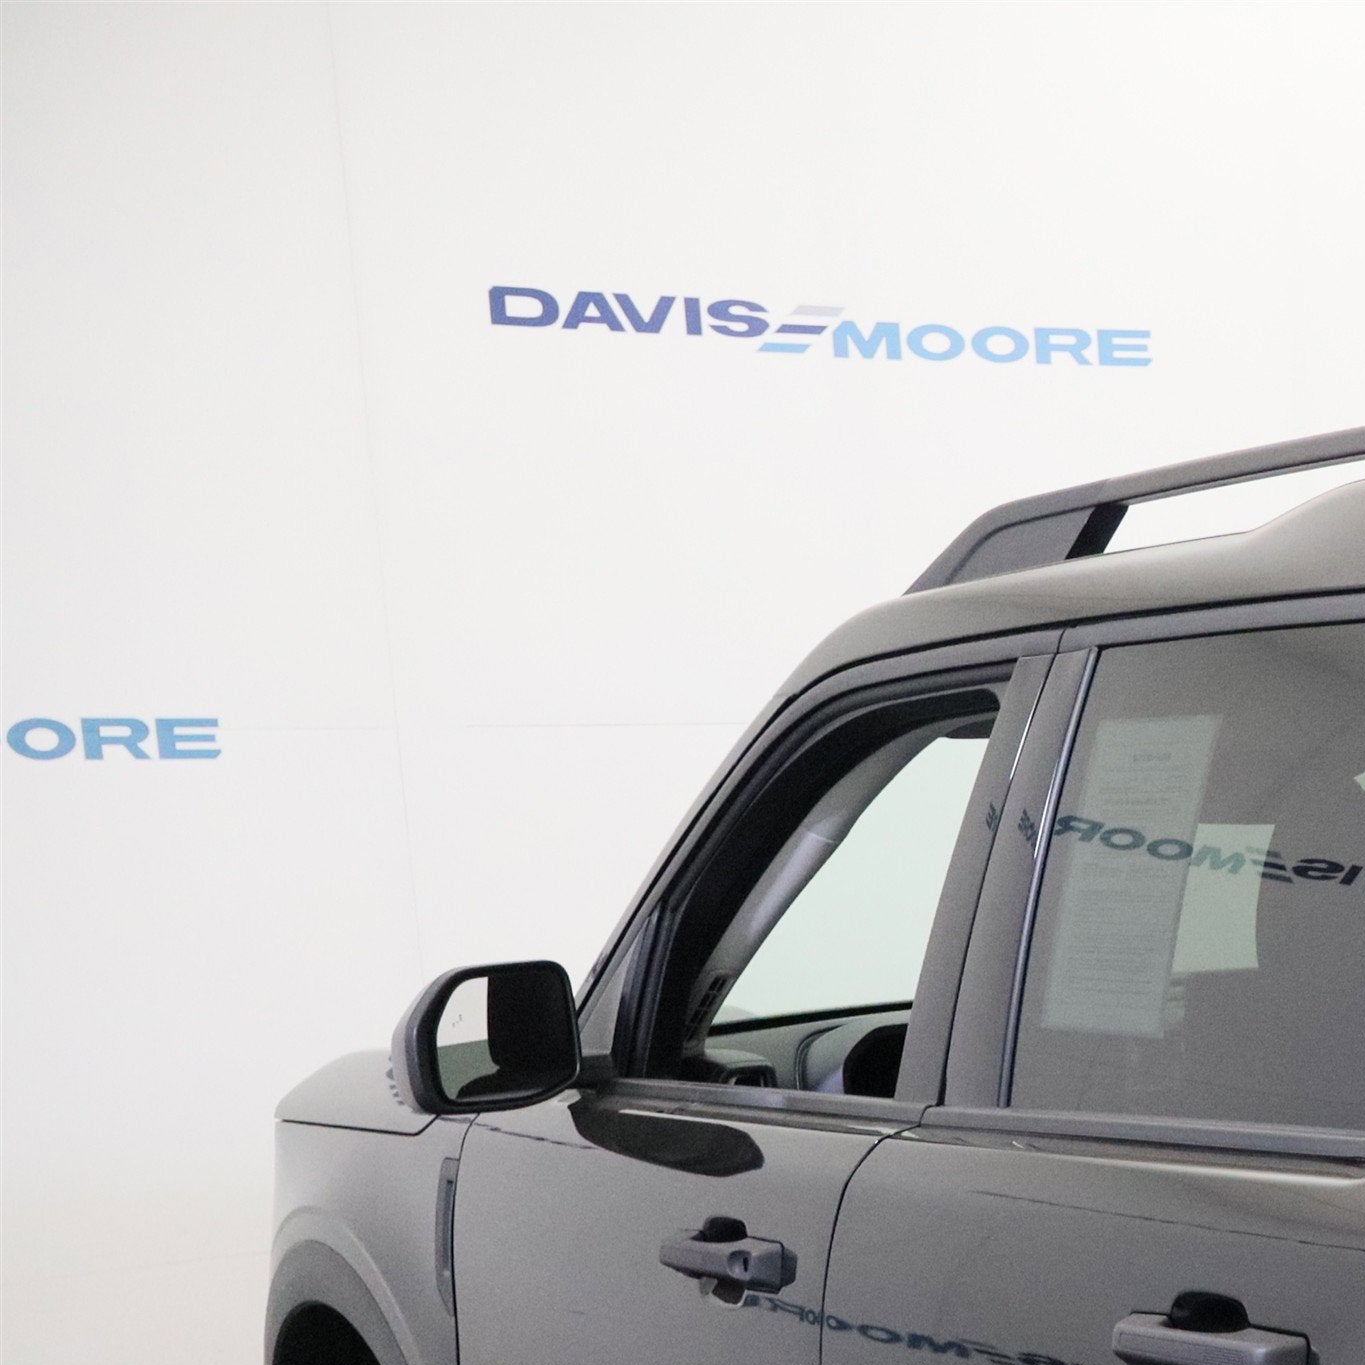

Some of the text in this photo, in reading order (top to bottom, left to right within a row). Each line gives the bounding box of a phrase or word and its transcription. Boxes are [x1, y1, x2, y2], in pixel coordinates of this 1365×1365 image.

[487, 285, 1153, 367] DAVIS MOORE
[6, 717, 222, 760] ORE
